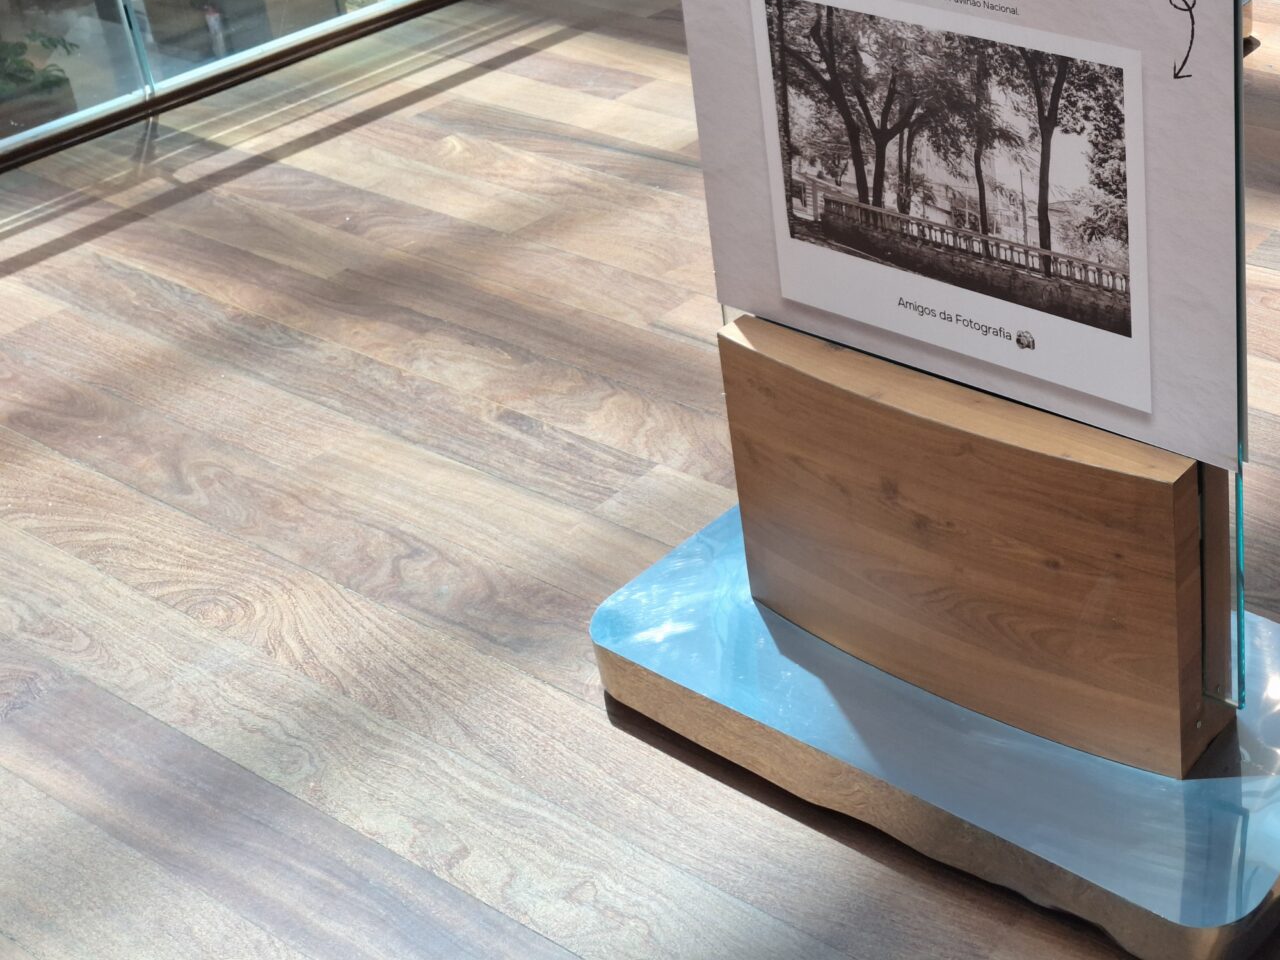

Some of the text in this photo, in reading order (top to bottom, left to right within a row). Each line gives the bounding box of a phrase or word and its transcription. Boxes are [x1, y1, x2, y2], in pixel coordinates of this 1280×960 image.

[983, 0, 1020, 16] Nacional.
[898, 296, 1012, 341] Amigos da Fotografia
